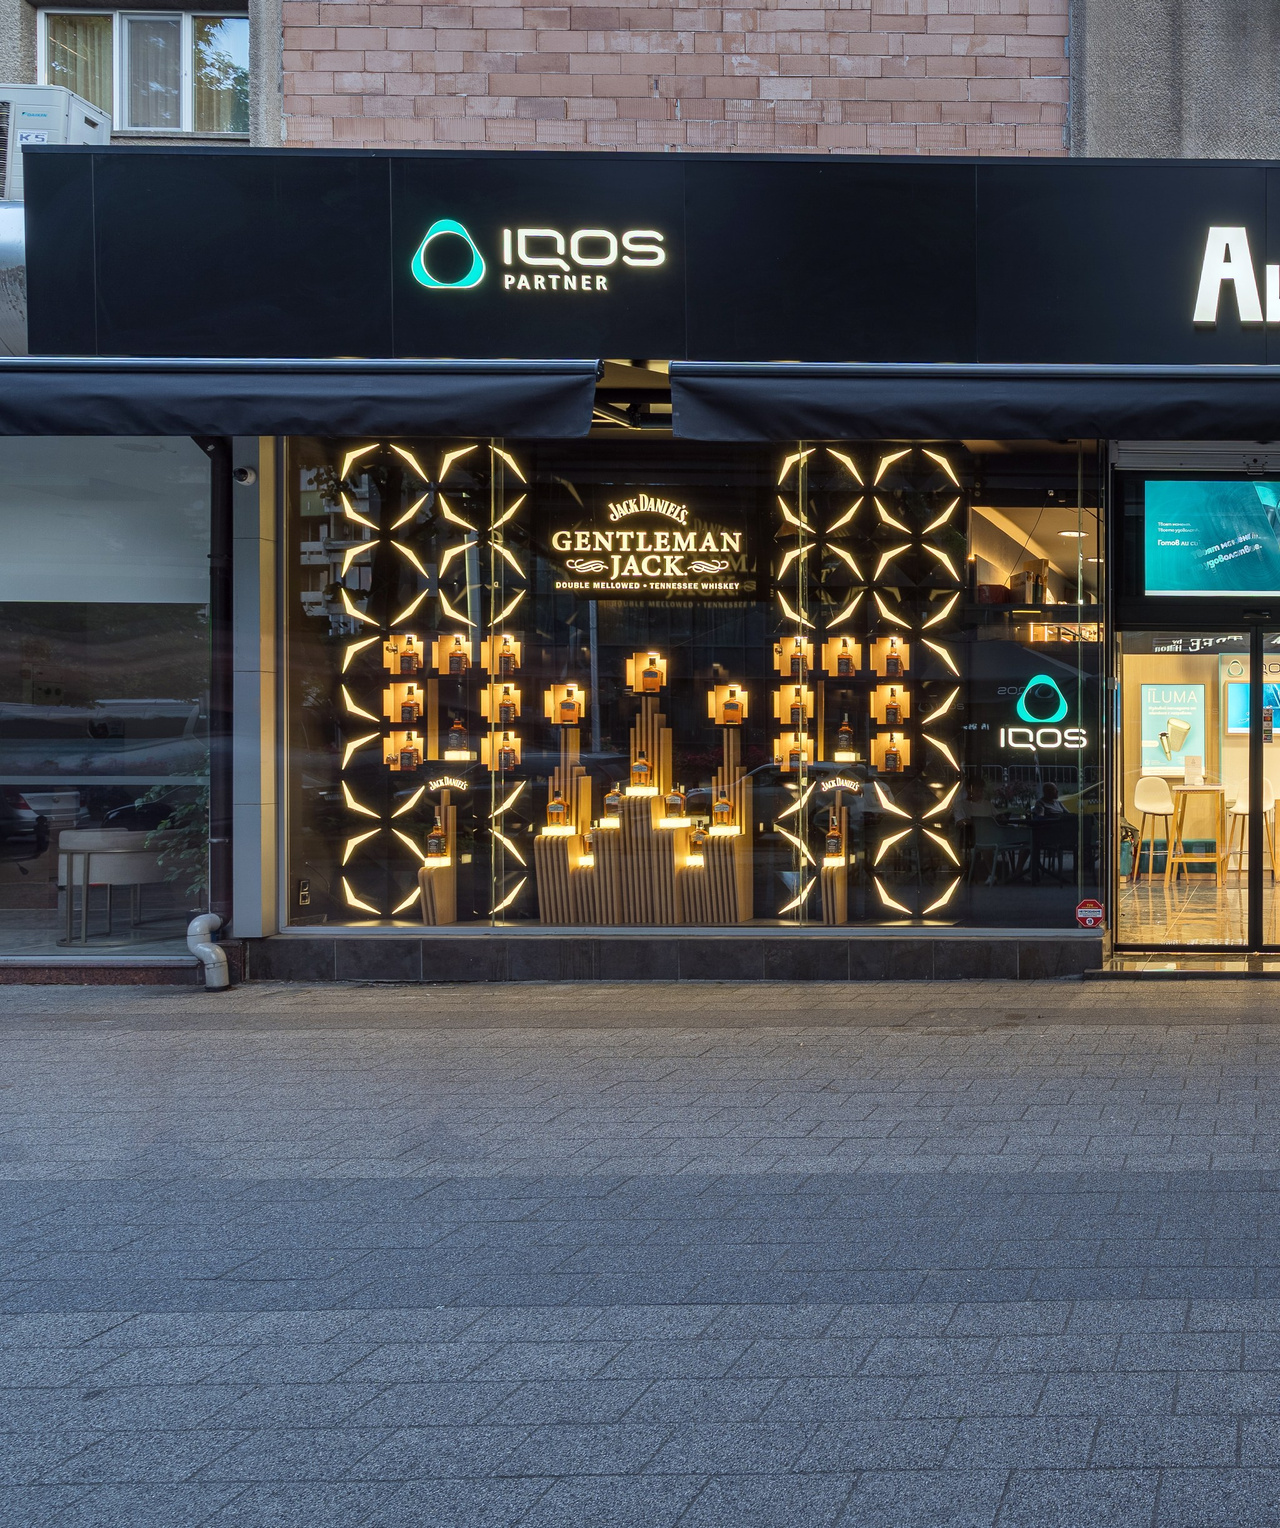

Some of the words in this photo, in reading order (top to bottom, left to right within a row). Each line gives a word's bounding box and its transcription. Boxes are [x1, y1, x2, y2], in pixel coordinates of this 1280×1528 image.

[503, 229, 666, 272] IQOS
[504, 274, 608, 291] PARTNER
[608, 499, 641, 521] JACK
[552, 531, 742, 553] GENTLEMAN
[556, 581, 590, 589] DOUBLE
[593, 581, 641, 589] MELLOWED
[650, 582, 699, 590] TENNESSEE
[701, 582, 740, 590] WHISKEY
[1000, 727, 1088, 751] IQOS
